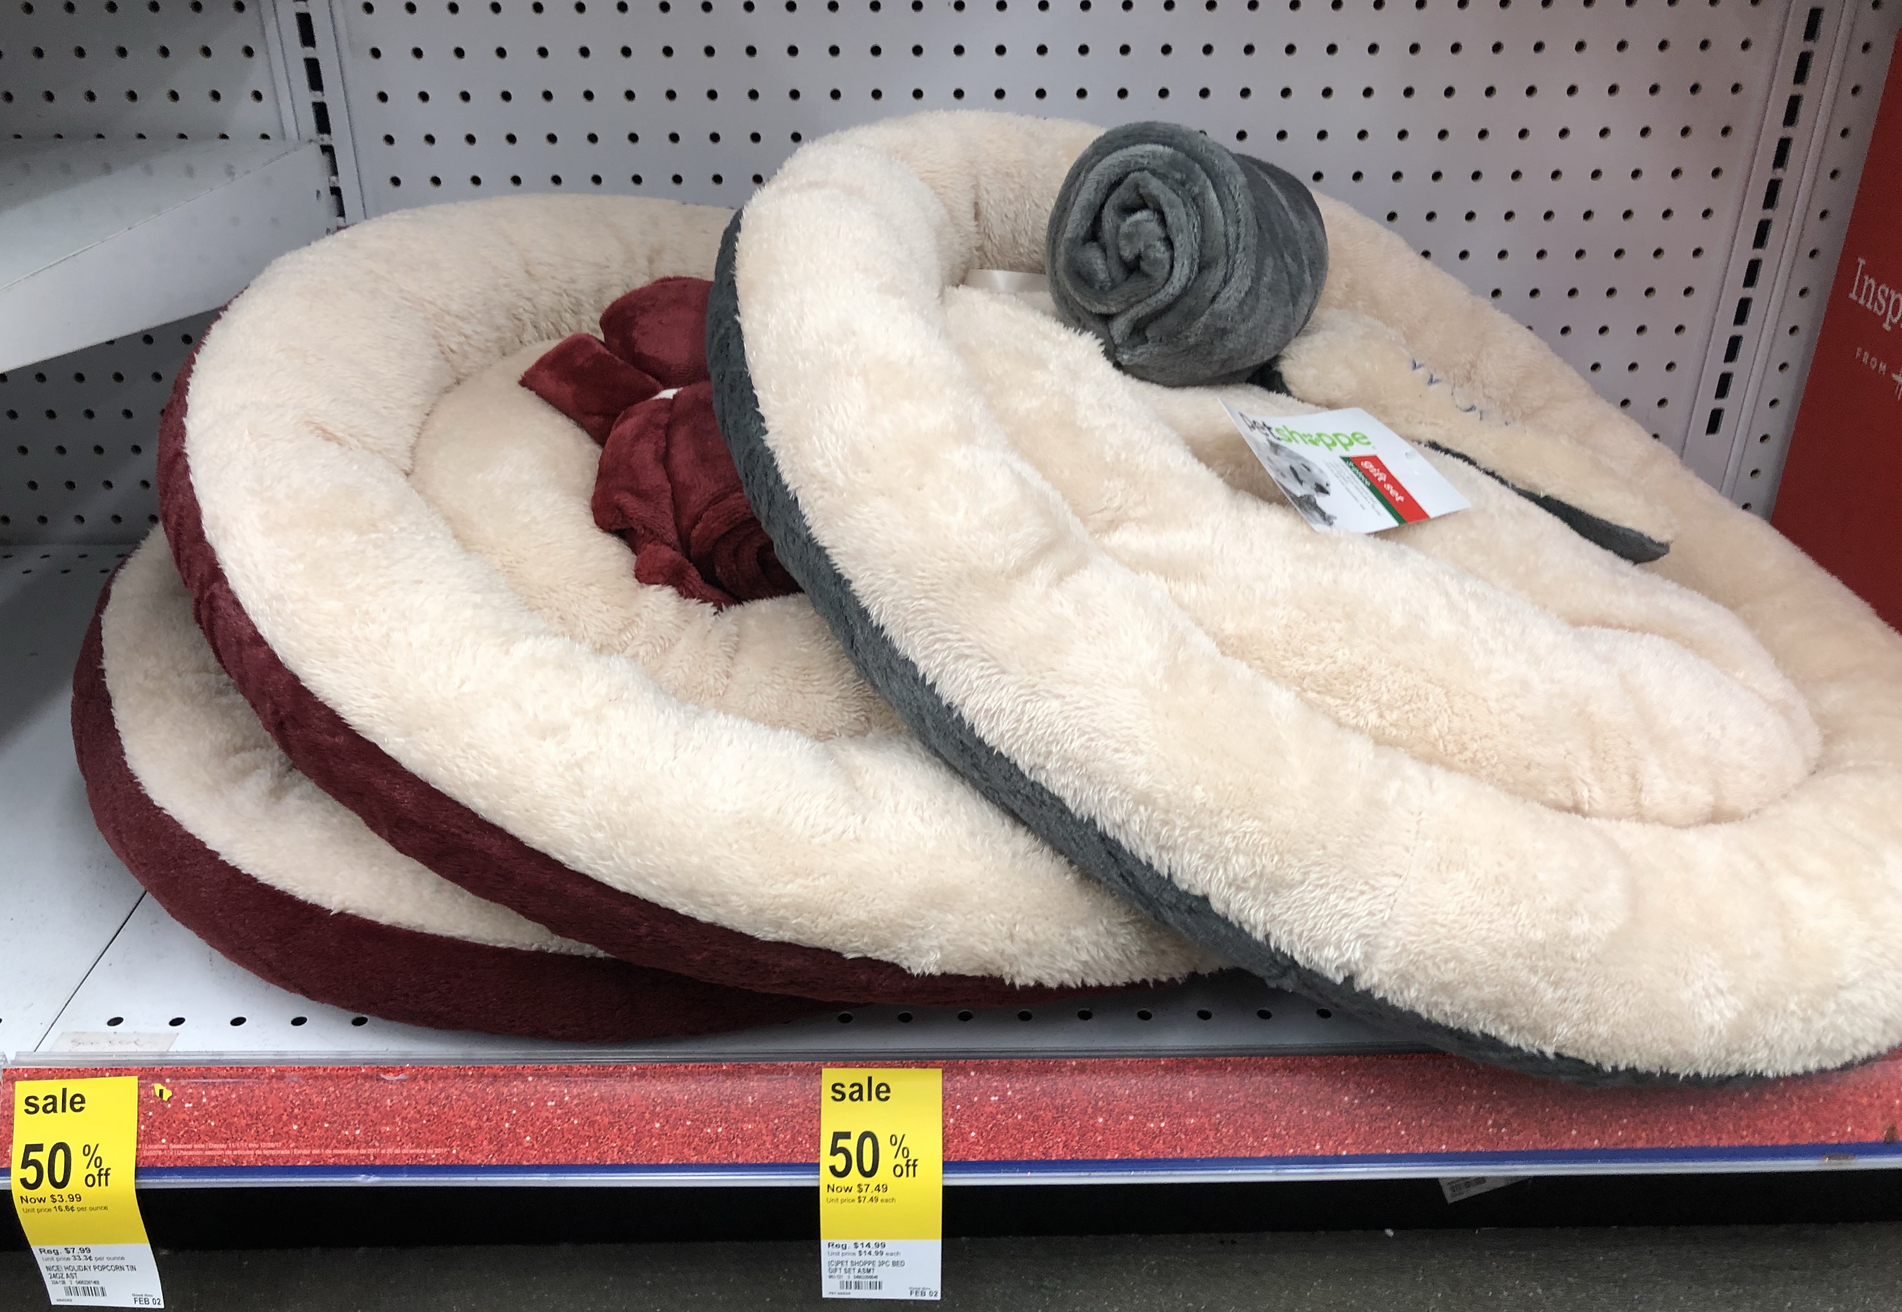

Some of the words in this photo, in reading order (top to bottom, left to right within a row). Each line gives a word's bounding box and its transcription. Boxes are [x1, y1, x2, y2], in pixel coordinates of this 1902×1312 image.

[1855, 348, 1887, 376] FROM
[1361, 460, 1387, 482] gift
[1383, 483, 1404, 502] set
[831, 1076, 891, 1102] sale
[23, 1087, 86, 1115] sale
[829, 1131, 880, 1178] 50
[889, 1134, 910, 1159] %
[19, 1141, 72, 1190] 50
[82, 1143, 103, 1169] %
[893, 1159, 918, 1178] off
[84, 1168, 111, 1188] off
[826, 1184, 853, 1193] Now
[856, 1183, 888, 1194] $7.49
[20, 1195, 46, 1204] Now
[50, 1193, 82, 1204] $3.99
[857, 1196, 879, 1204] $7.49
[39, 1248, 62, 1256] Reg.
[64, 1247, 91, 1255] $7.99
[828, 1242, 850, 1250] Reg.
[853, 1242, 886, 1250] $14.99
[66, 1272, 78, 1280] AST
